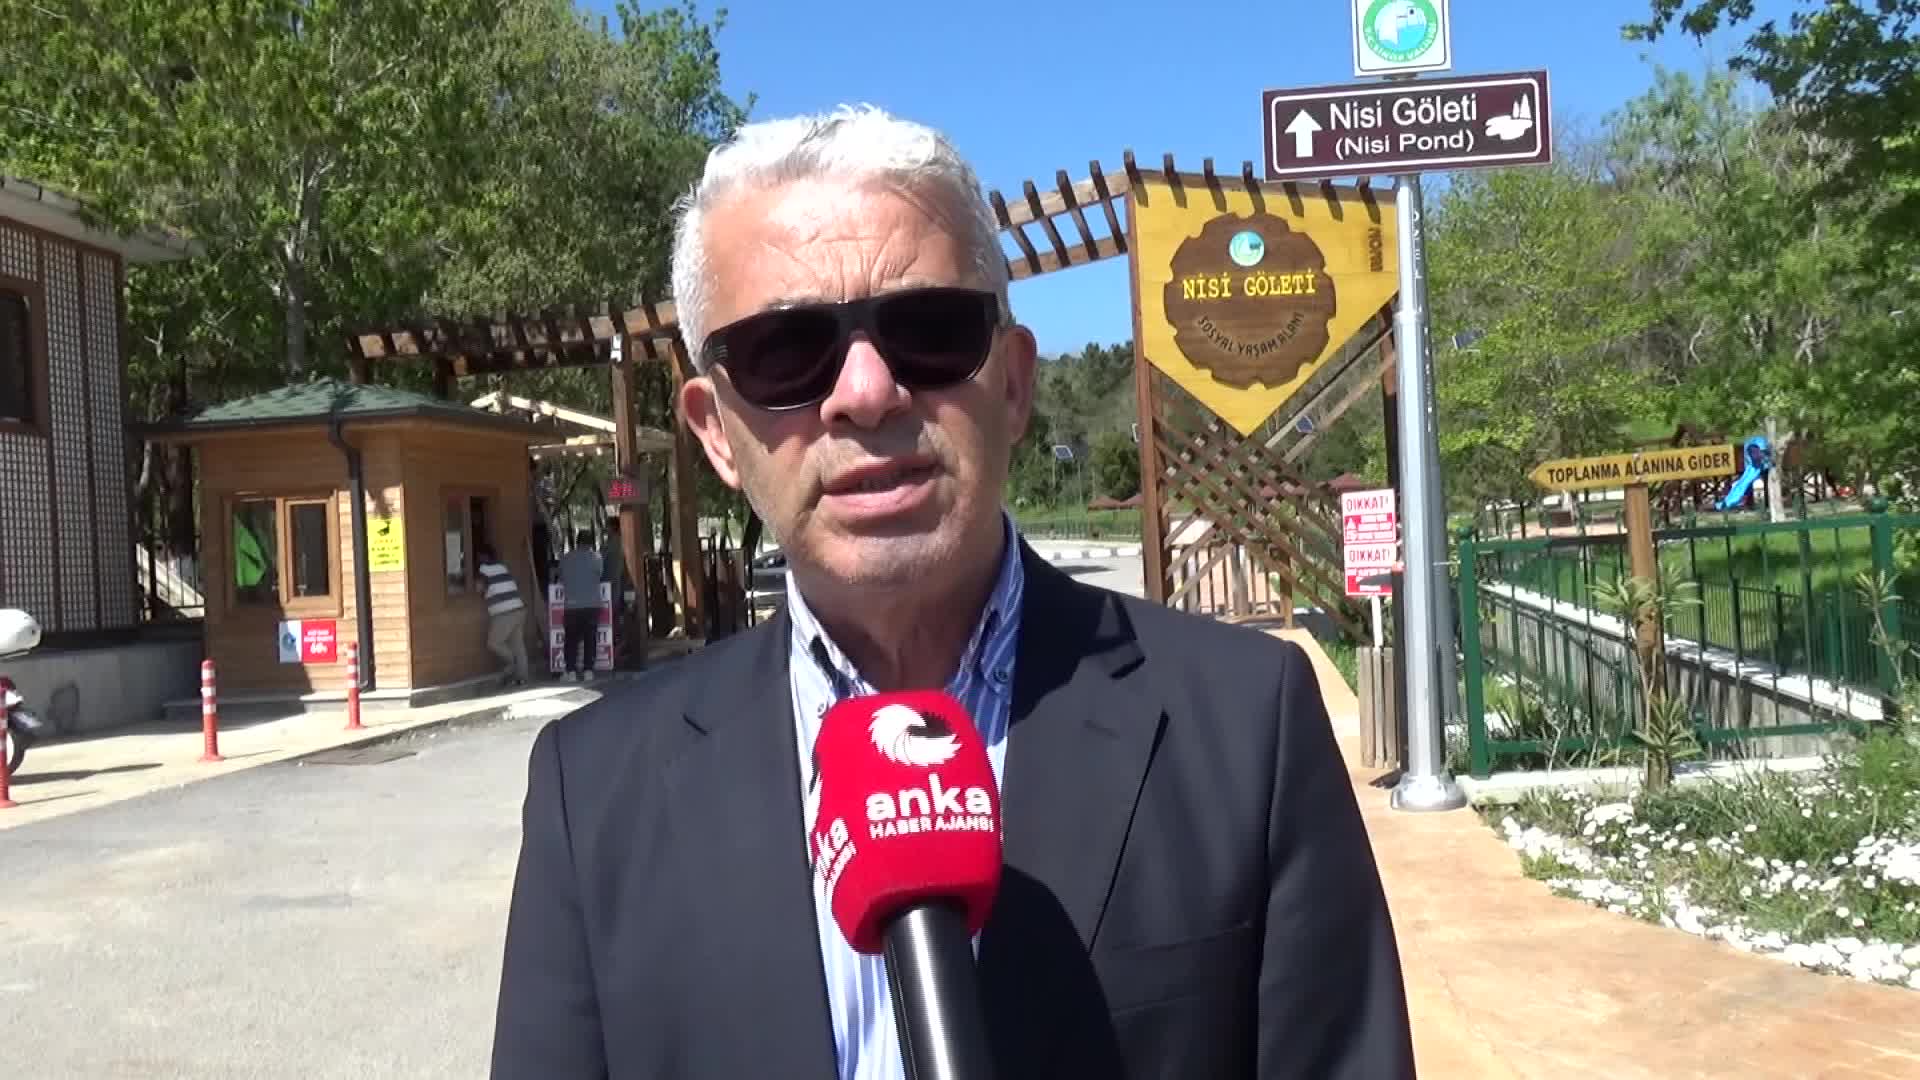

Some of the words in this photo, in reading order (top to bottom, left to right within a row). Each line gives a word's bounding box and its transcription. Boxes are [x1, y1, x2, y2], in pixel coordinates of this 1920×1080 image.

[1329, 101, 1382, 130] Nisi
[1392, 93, 1477, 126] Göleti
[1335, 136, 1390, 159] (Nisi
[1399, 129, 1474, 152] Pond)
[1183, 271, 1231, 299] NİSİ
[1244, 267, 1316, 297] GÖLETİ
[1198, 315, 1234, 353] SOSYAL
[1548, 463, 1620, 483] TOPLANMA
[1624, 454, 1684, 476] ALANINA
[866, 773, 992, 820] anka
[869, 818, 931, 839] HABER
[935, 816, 994, 832] AJANSI
